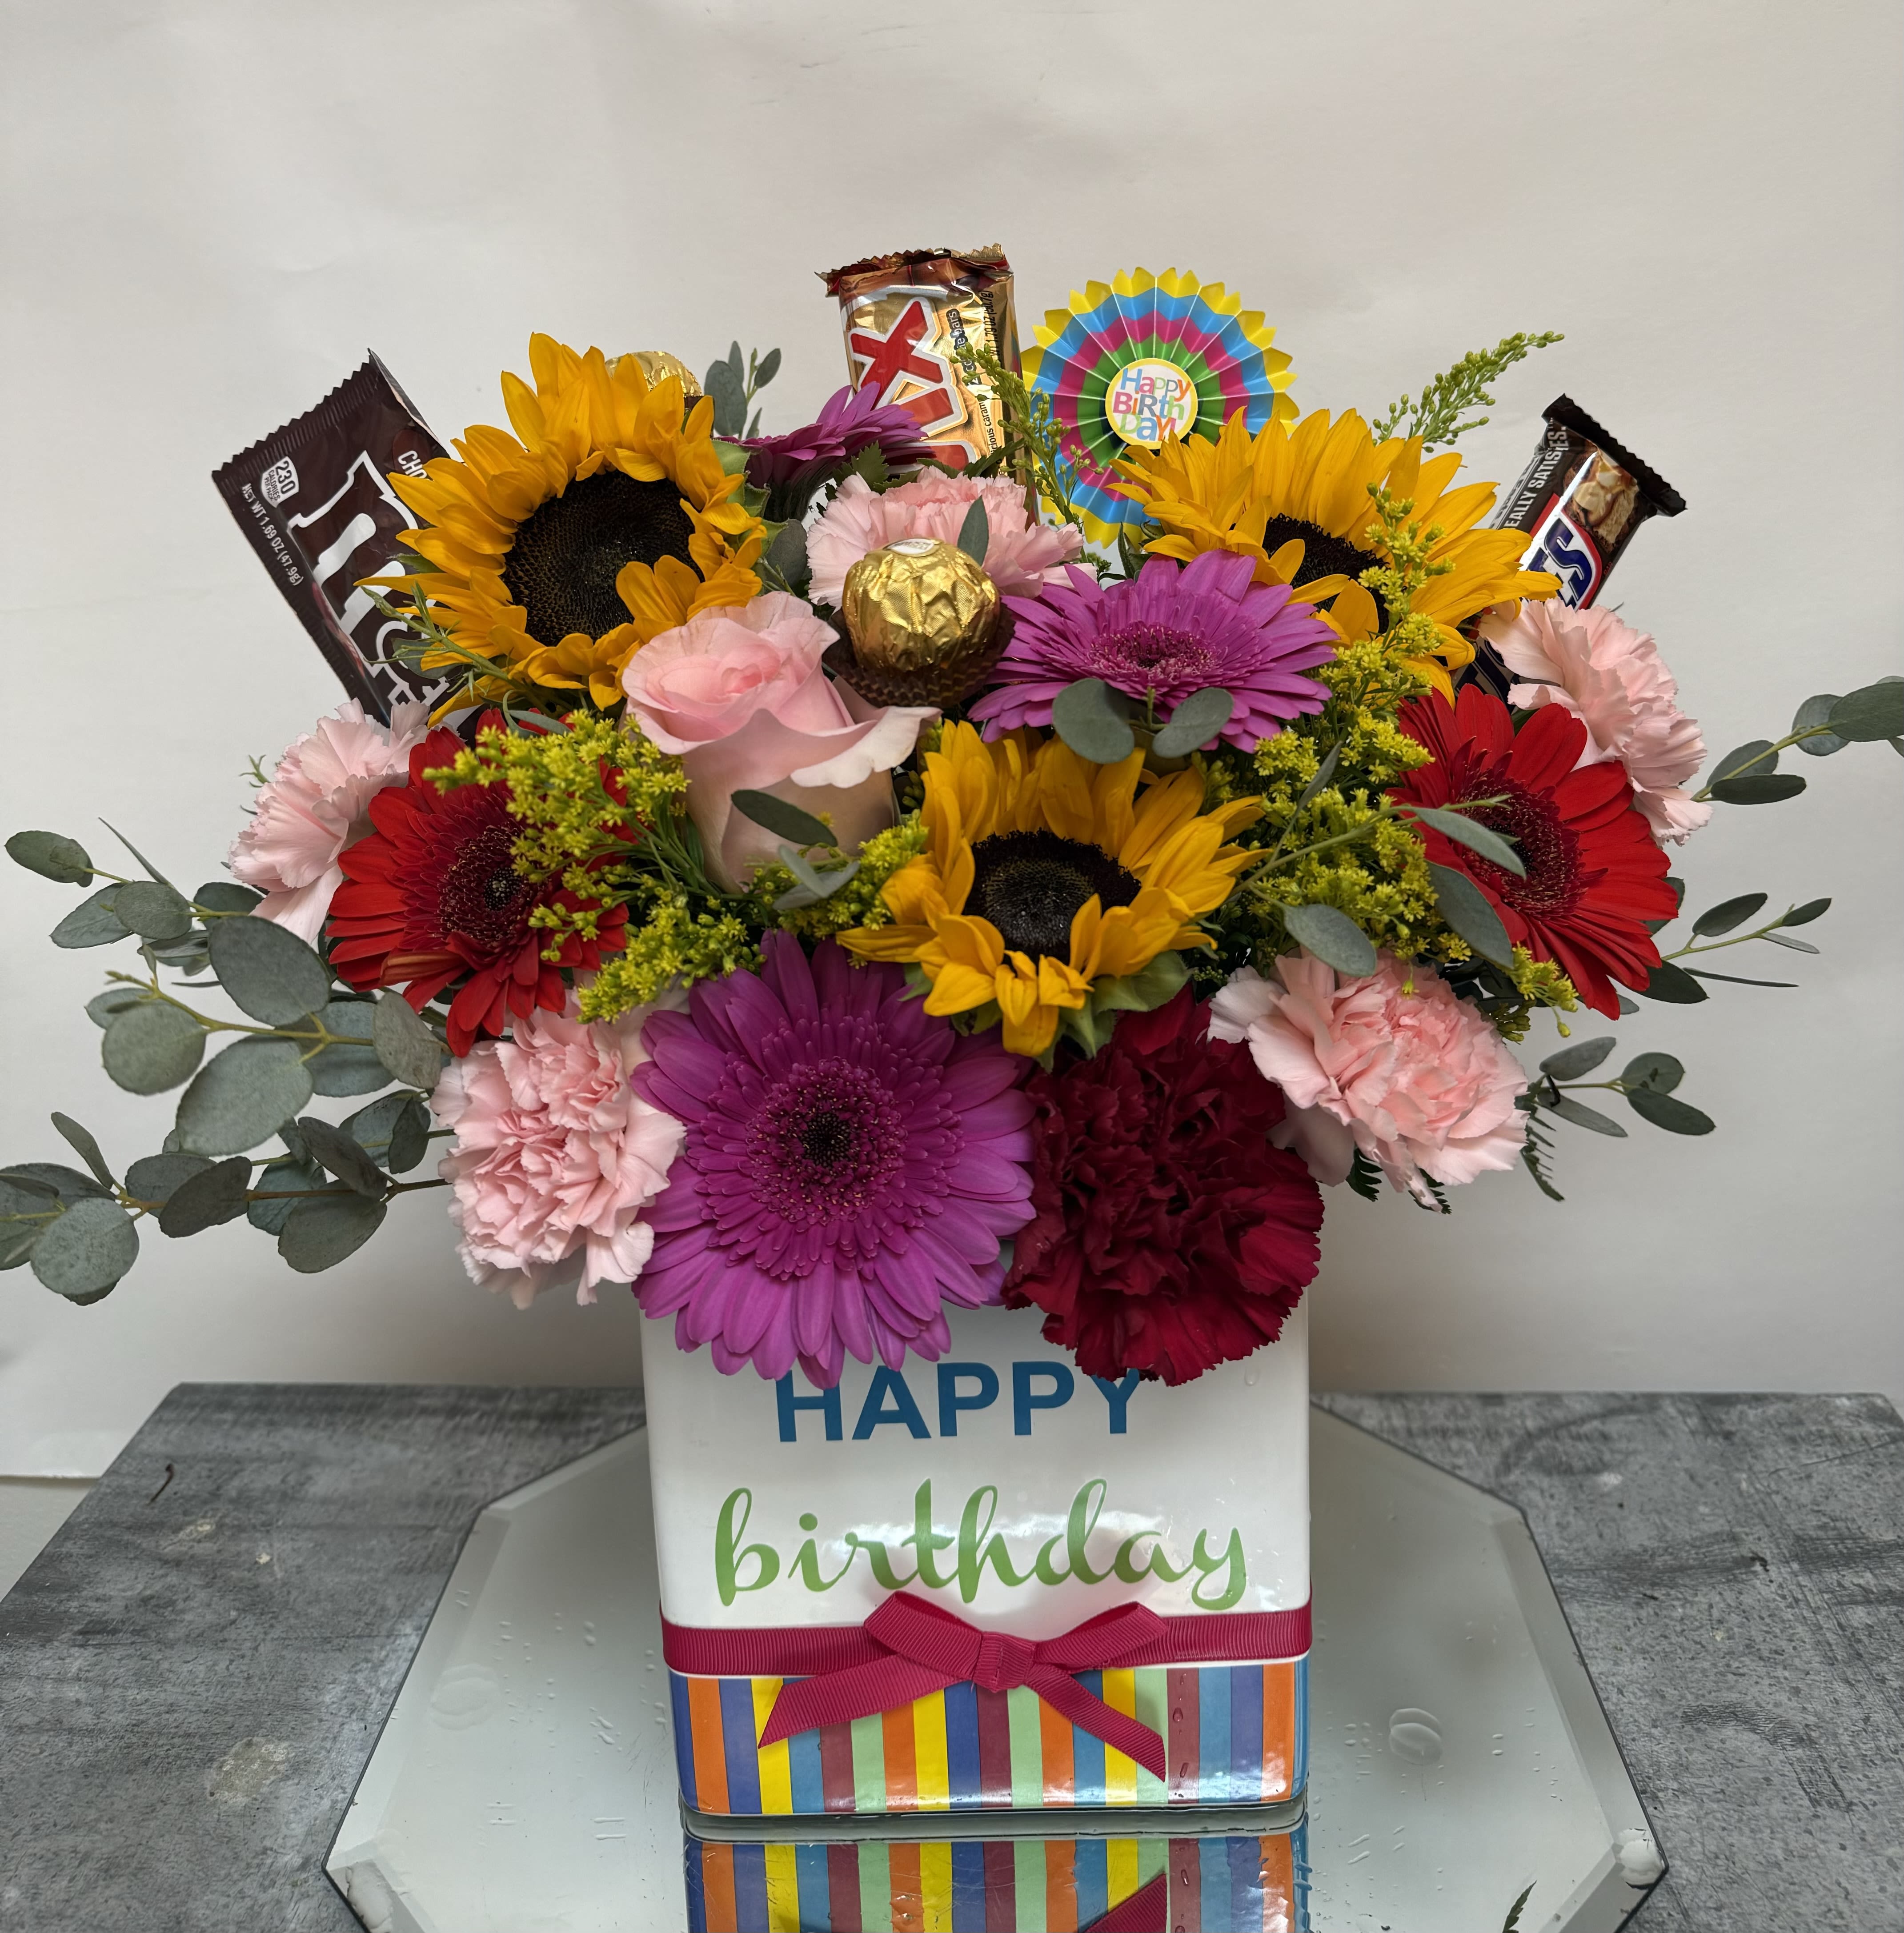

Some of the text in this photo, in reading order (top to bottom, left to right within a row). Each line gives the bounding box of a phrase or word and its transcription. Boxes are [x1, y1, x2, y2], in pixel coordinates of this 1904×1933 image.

[949, 311, 962, 337] bars
[984, 328, 998, 343] 1.79
[1120, 368, 1191, 402] Happy
[268, 469, 281, 501] CALORIES
[275, 460, 296, 494] 230
[1504, 490, 1537, 529] EALLY
[242, 483, 304, 586] NET WT 1.69 OZ (47.9g)
[776, 1361, 1142, 1443] HAPPY
[714, 1477, 1247, 1611] birthday
